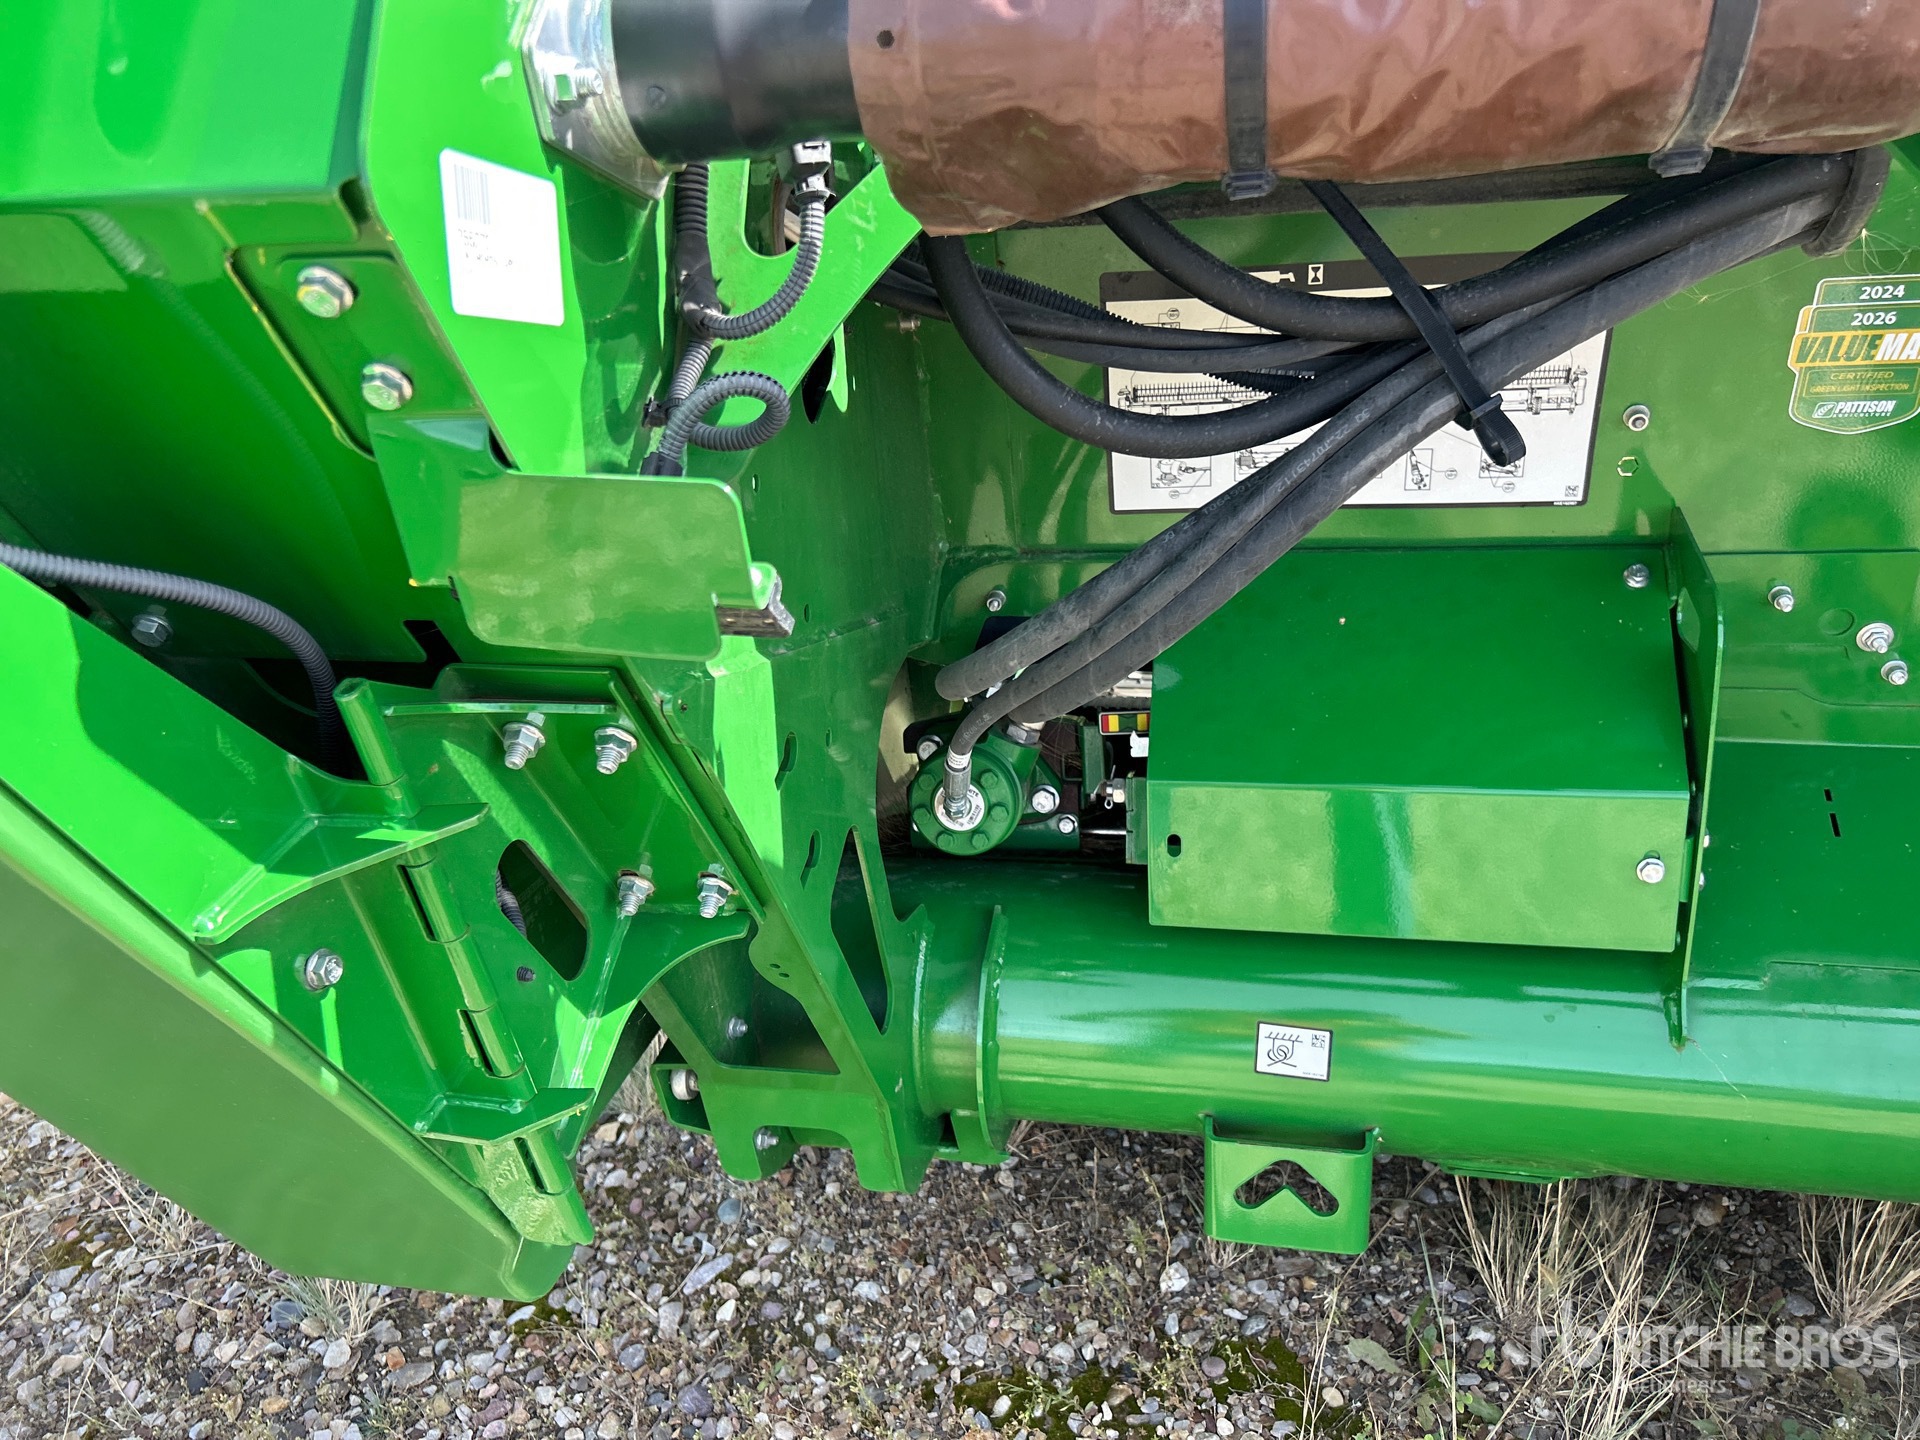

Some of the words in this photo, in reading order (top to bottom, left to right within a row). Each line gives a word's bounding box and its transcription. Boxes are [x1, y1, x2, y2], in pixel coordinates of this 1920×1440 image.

[1859, 285, 1905, 300] 2024
[1851, 311, 1897, 326] 2026
[1830, 371, 1894, 380] CERTIFIED
[1837, 384, 1860, 392] LIGHT
[1861, 383, 1910, 391] INSPECTION
[1834, 400, 1896, 414] PATTISON
